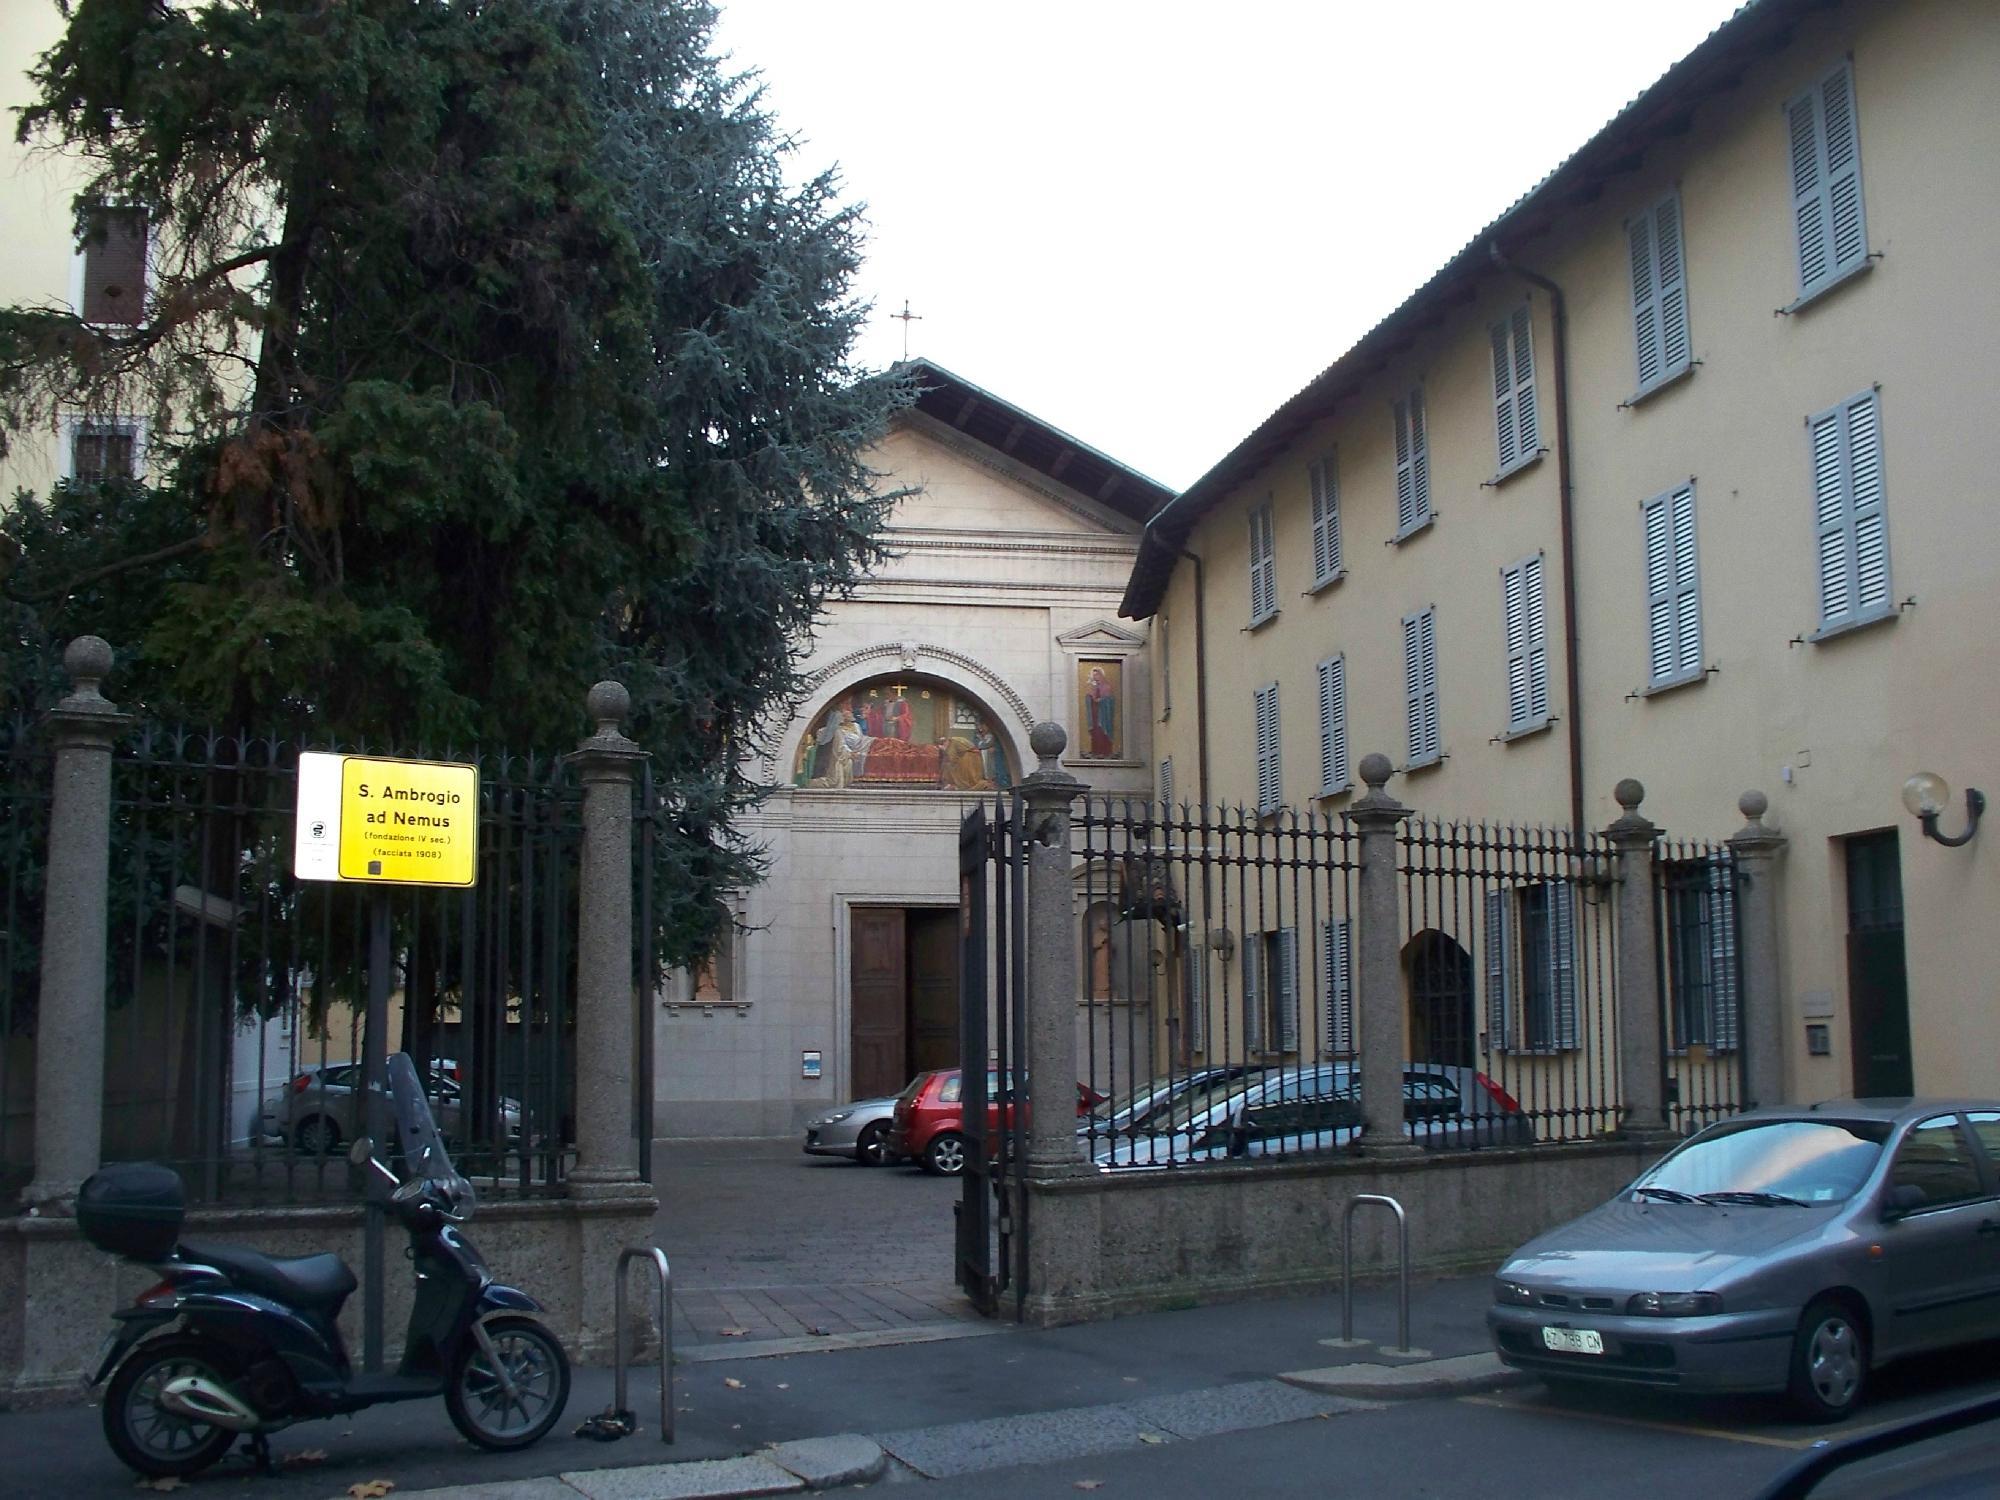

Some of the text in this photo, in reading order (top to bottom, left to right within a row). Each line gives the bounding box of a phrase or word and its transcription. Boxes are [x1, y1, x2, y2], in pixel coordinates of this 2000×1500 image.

[358, 783, 460, 806] S. Ambrogio
[366, 811, 450, 828] ad Nemus
[364, 831, 451, 845] (fondazione IV sec.)
[372, 848, 442, 859] (facciata 1908)
[1587, 1335, 1601, 1349] CN
